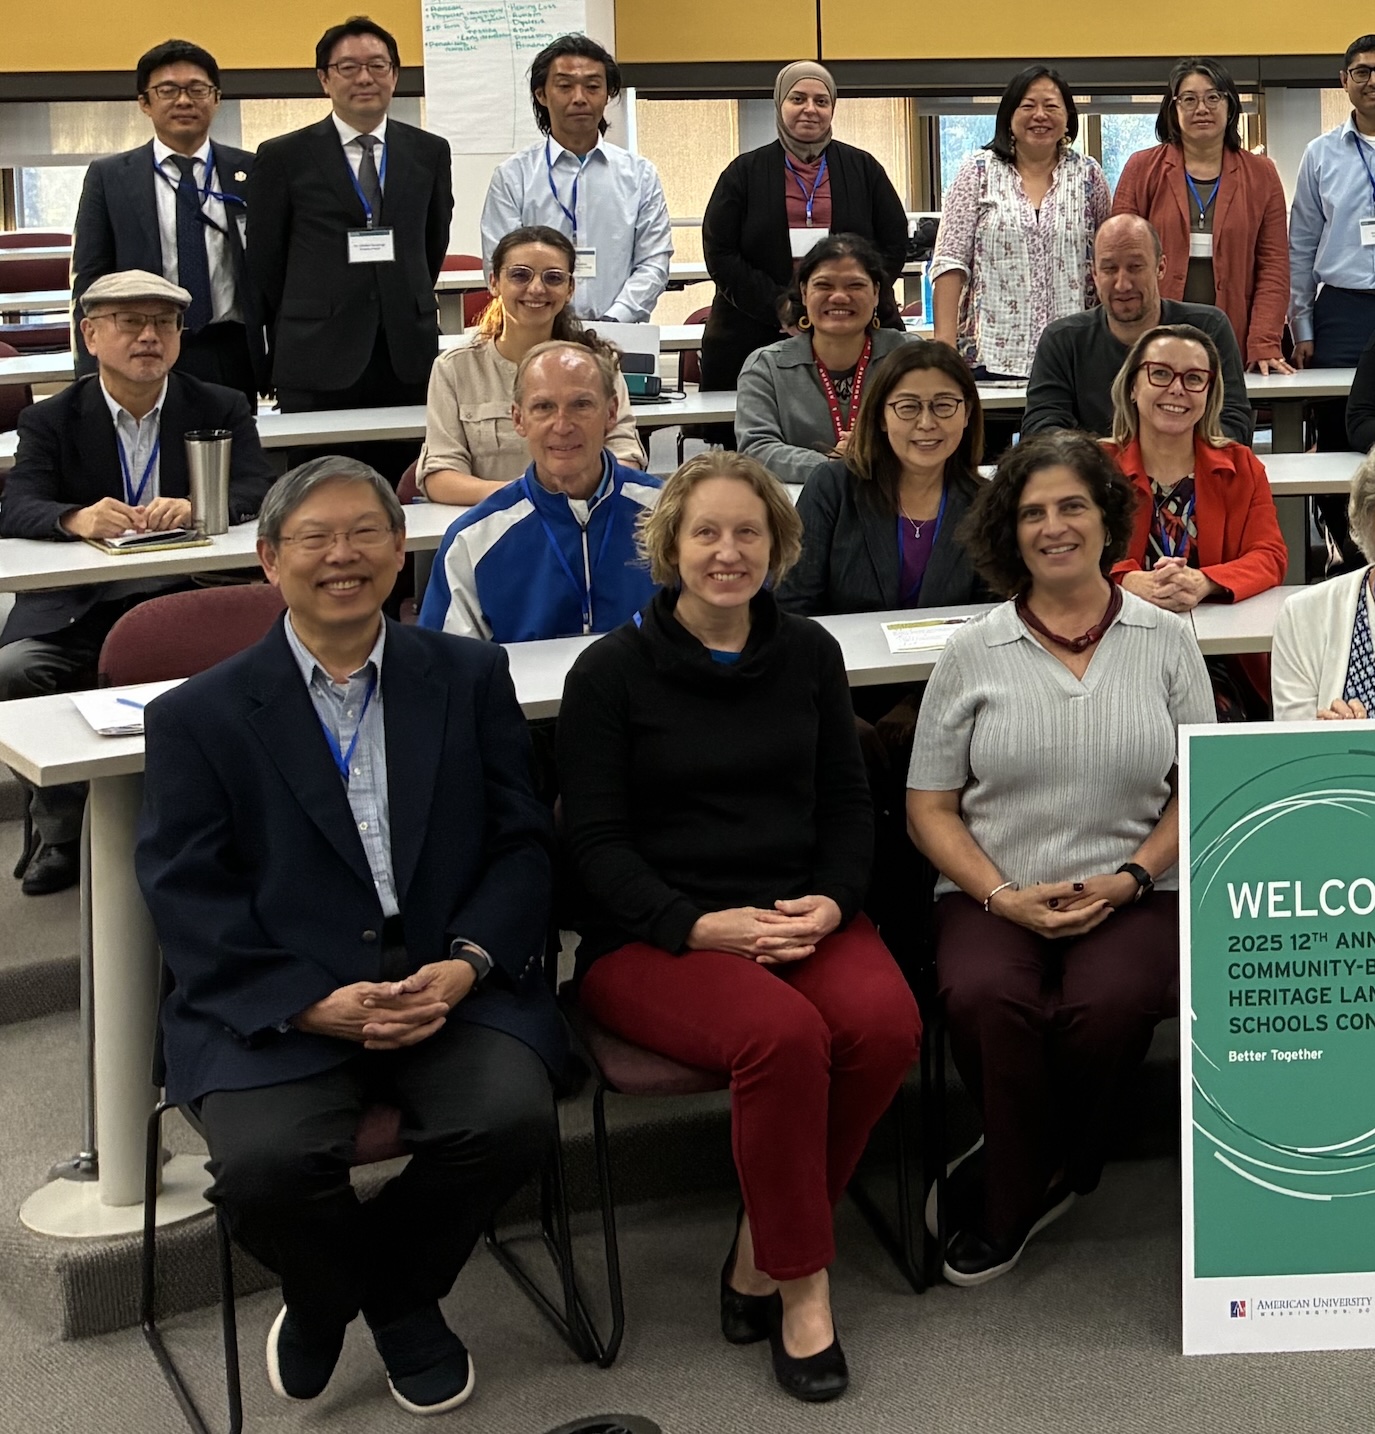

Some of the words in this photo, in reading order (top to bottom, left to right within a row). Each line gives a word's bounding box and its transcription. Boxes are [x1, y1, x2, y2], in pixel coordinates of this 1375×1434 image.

[1229, 935, 1282, 952] 2025
[1230, 987, 1331, 1007] HERITAGE
[1230, 1015, 1328, 1034] SCHOOLS
[1229, 1050, 1267, 1062] Better
[1271, 1049, 1323, 1062] Together
[1257, 1299, 1310, 1310] AMERICAN
[1314, 1297, 1372, 1309] UNIVERSITY
